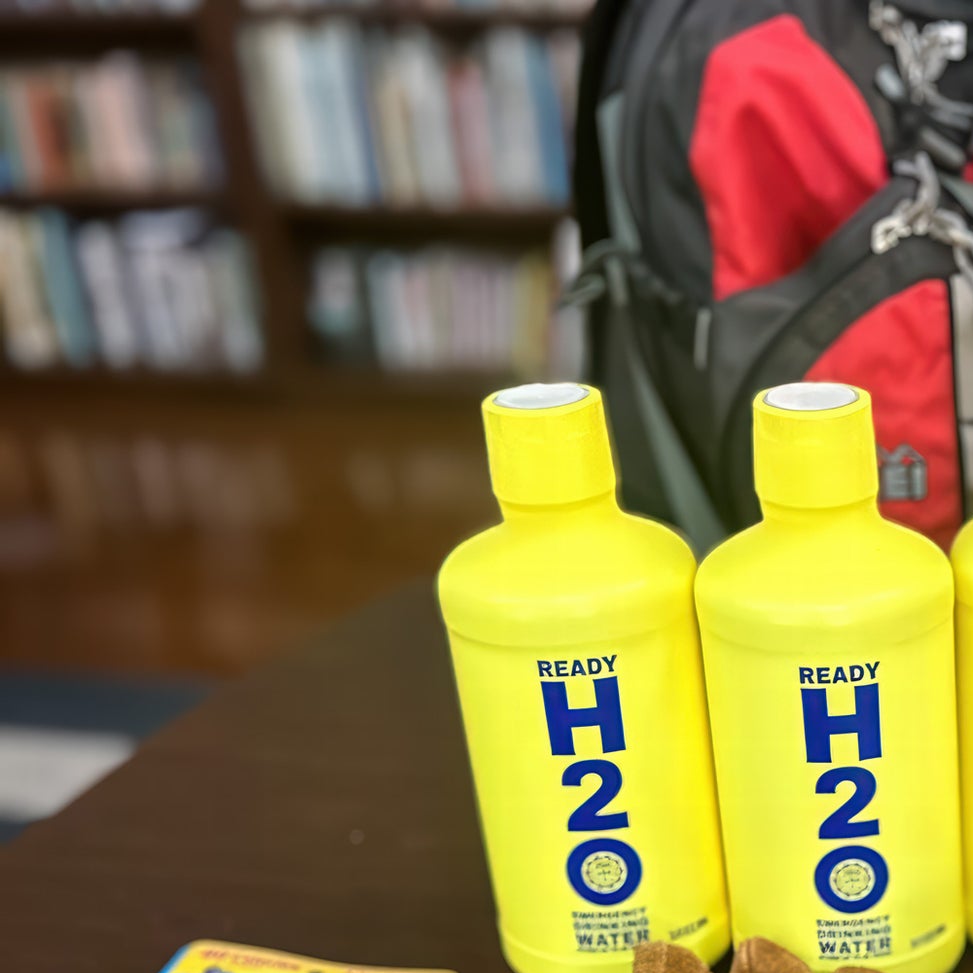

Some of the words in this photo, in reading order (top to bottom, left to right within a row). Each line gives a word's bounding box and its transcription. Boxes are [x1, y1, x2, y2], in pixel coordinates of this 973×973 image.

[537, 655, 617, 677] READY
[799, 661, 880, 684] READY
[576, 930, 649, 945] WATER
[819, 937, 892, 955] WATER
